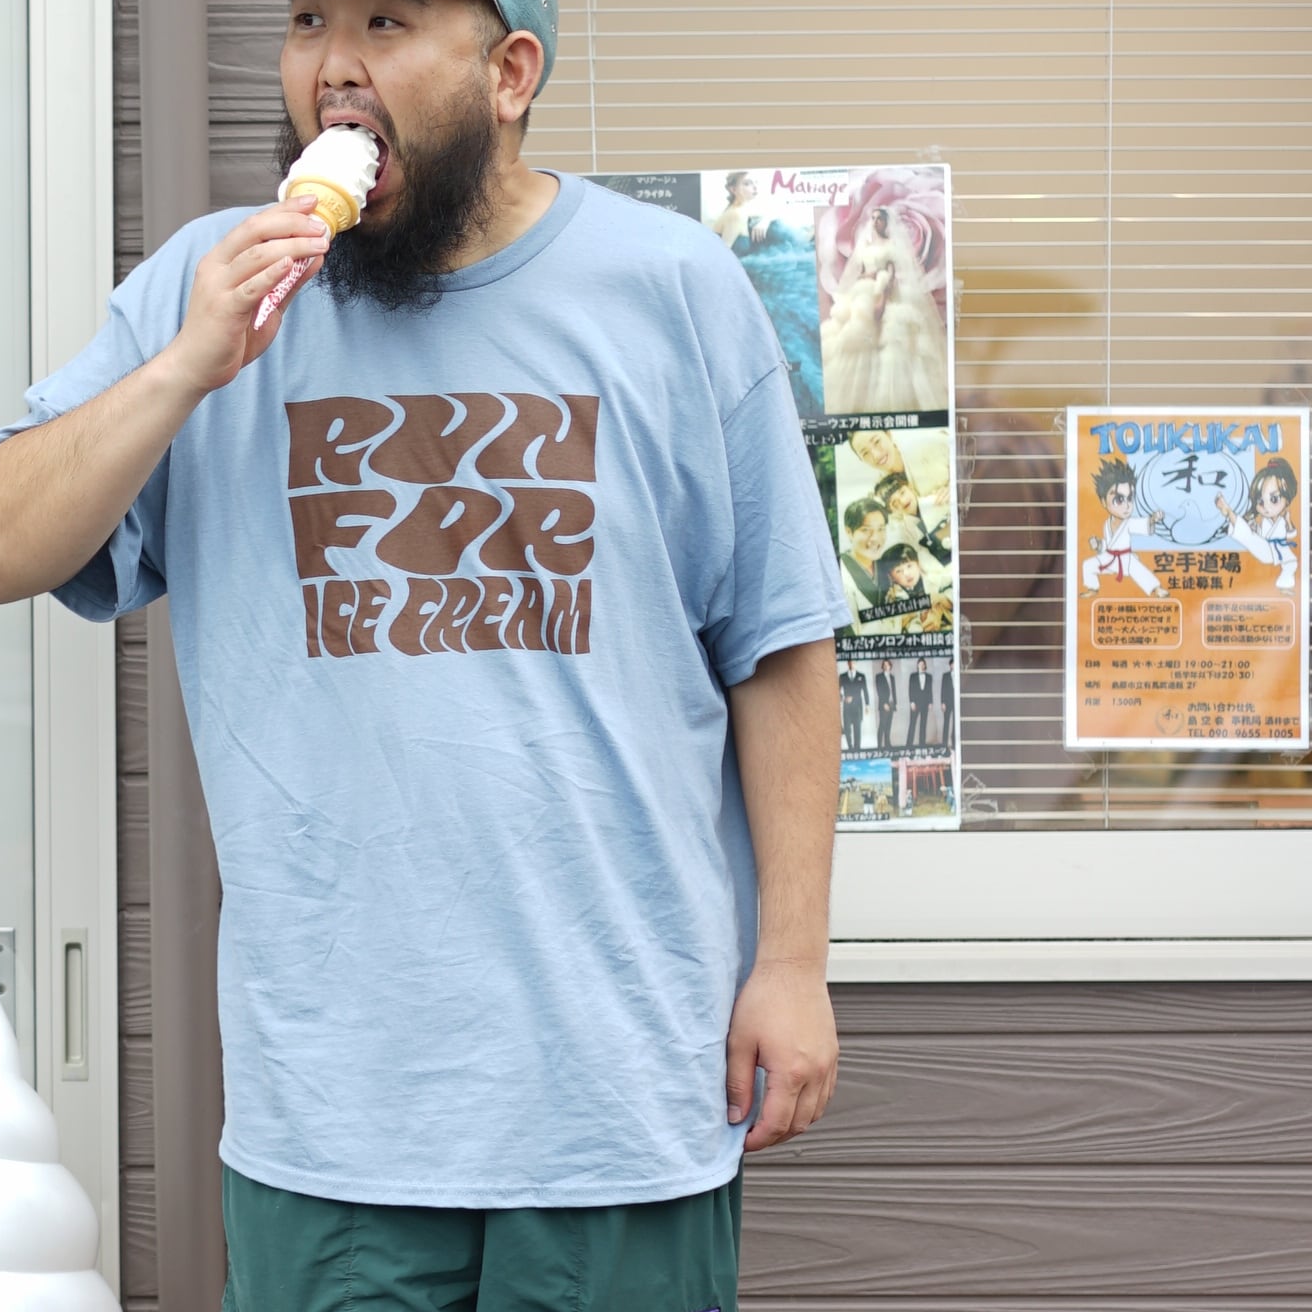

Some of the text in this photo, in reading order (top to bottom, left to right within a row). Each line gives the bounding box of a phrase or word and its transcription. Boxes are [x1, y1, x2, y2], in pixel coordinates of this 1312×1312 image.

[285, 392, 600, 489] RUN
[1090, 420, 1283, 455] TOUKUKAI
[1161, 454, 1228, 494] 和
[289, 485, 596, 579] FOR
[1153, 551, 1242, 574] 空手道場
[302, 575, 593, 658] ICE CREAM
